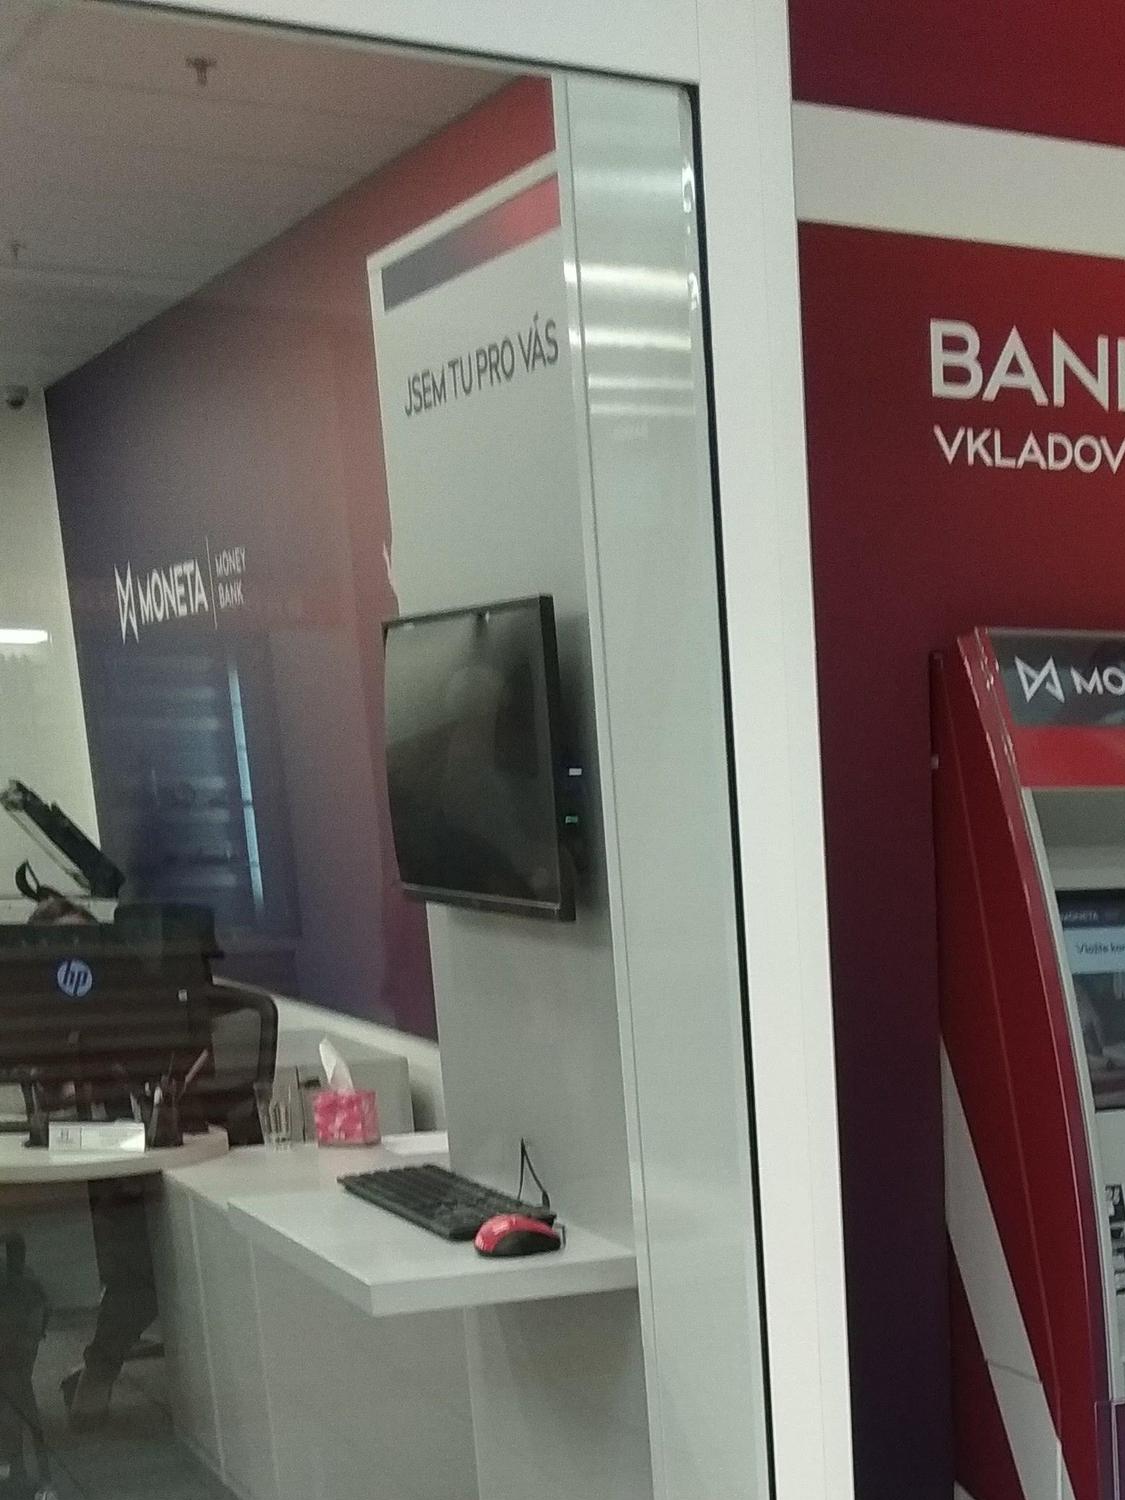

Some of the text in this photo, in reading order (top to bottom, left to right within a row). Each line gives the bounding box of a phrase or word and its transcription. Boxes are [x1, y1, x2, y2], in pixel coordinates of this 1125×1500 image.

[404, 311, 559, 418] JSEM TU PRO VÁS
[214, 546, 247, 578] MONEY
[136, 558, 209, 626] MONETA
[217, 577, 245, 609] BANK
[60, 959, 91, 997] hp
